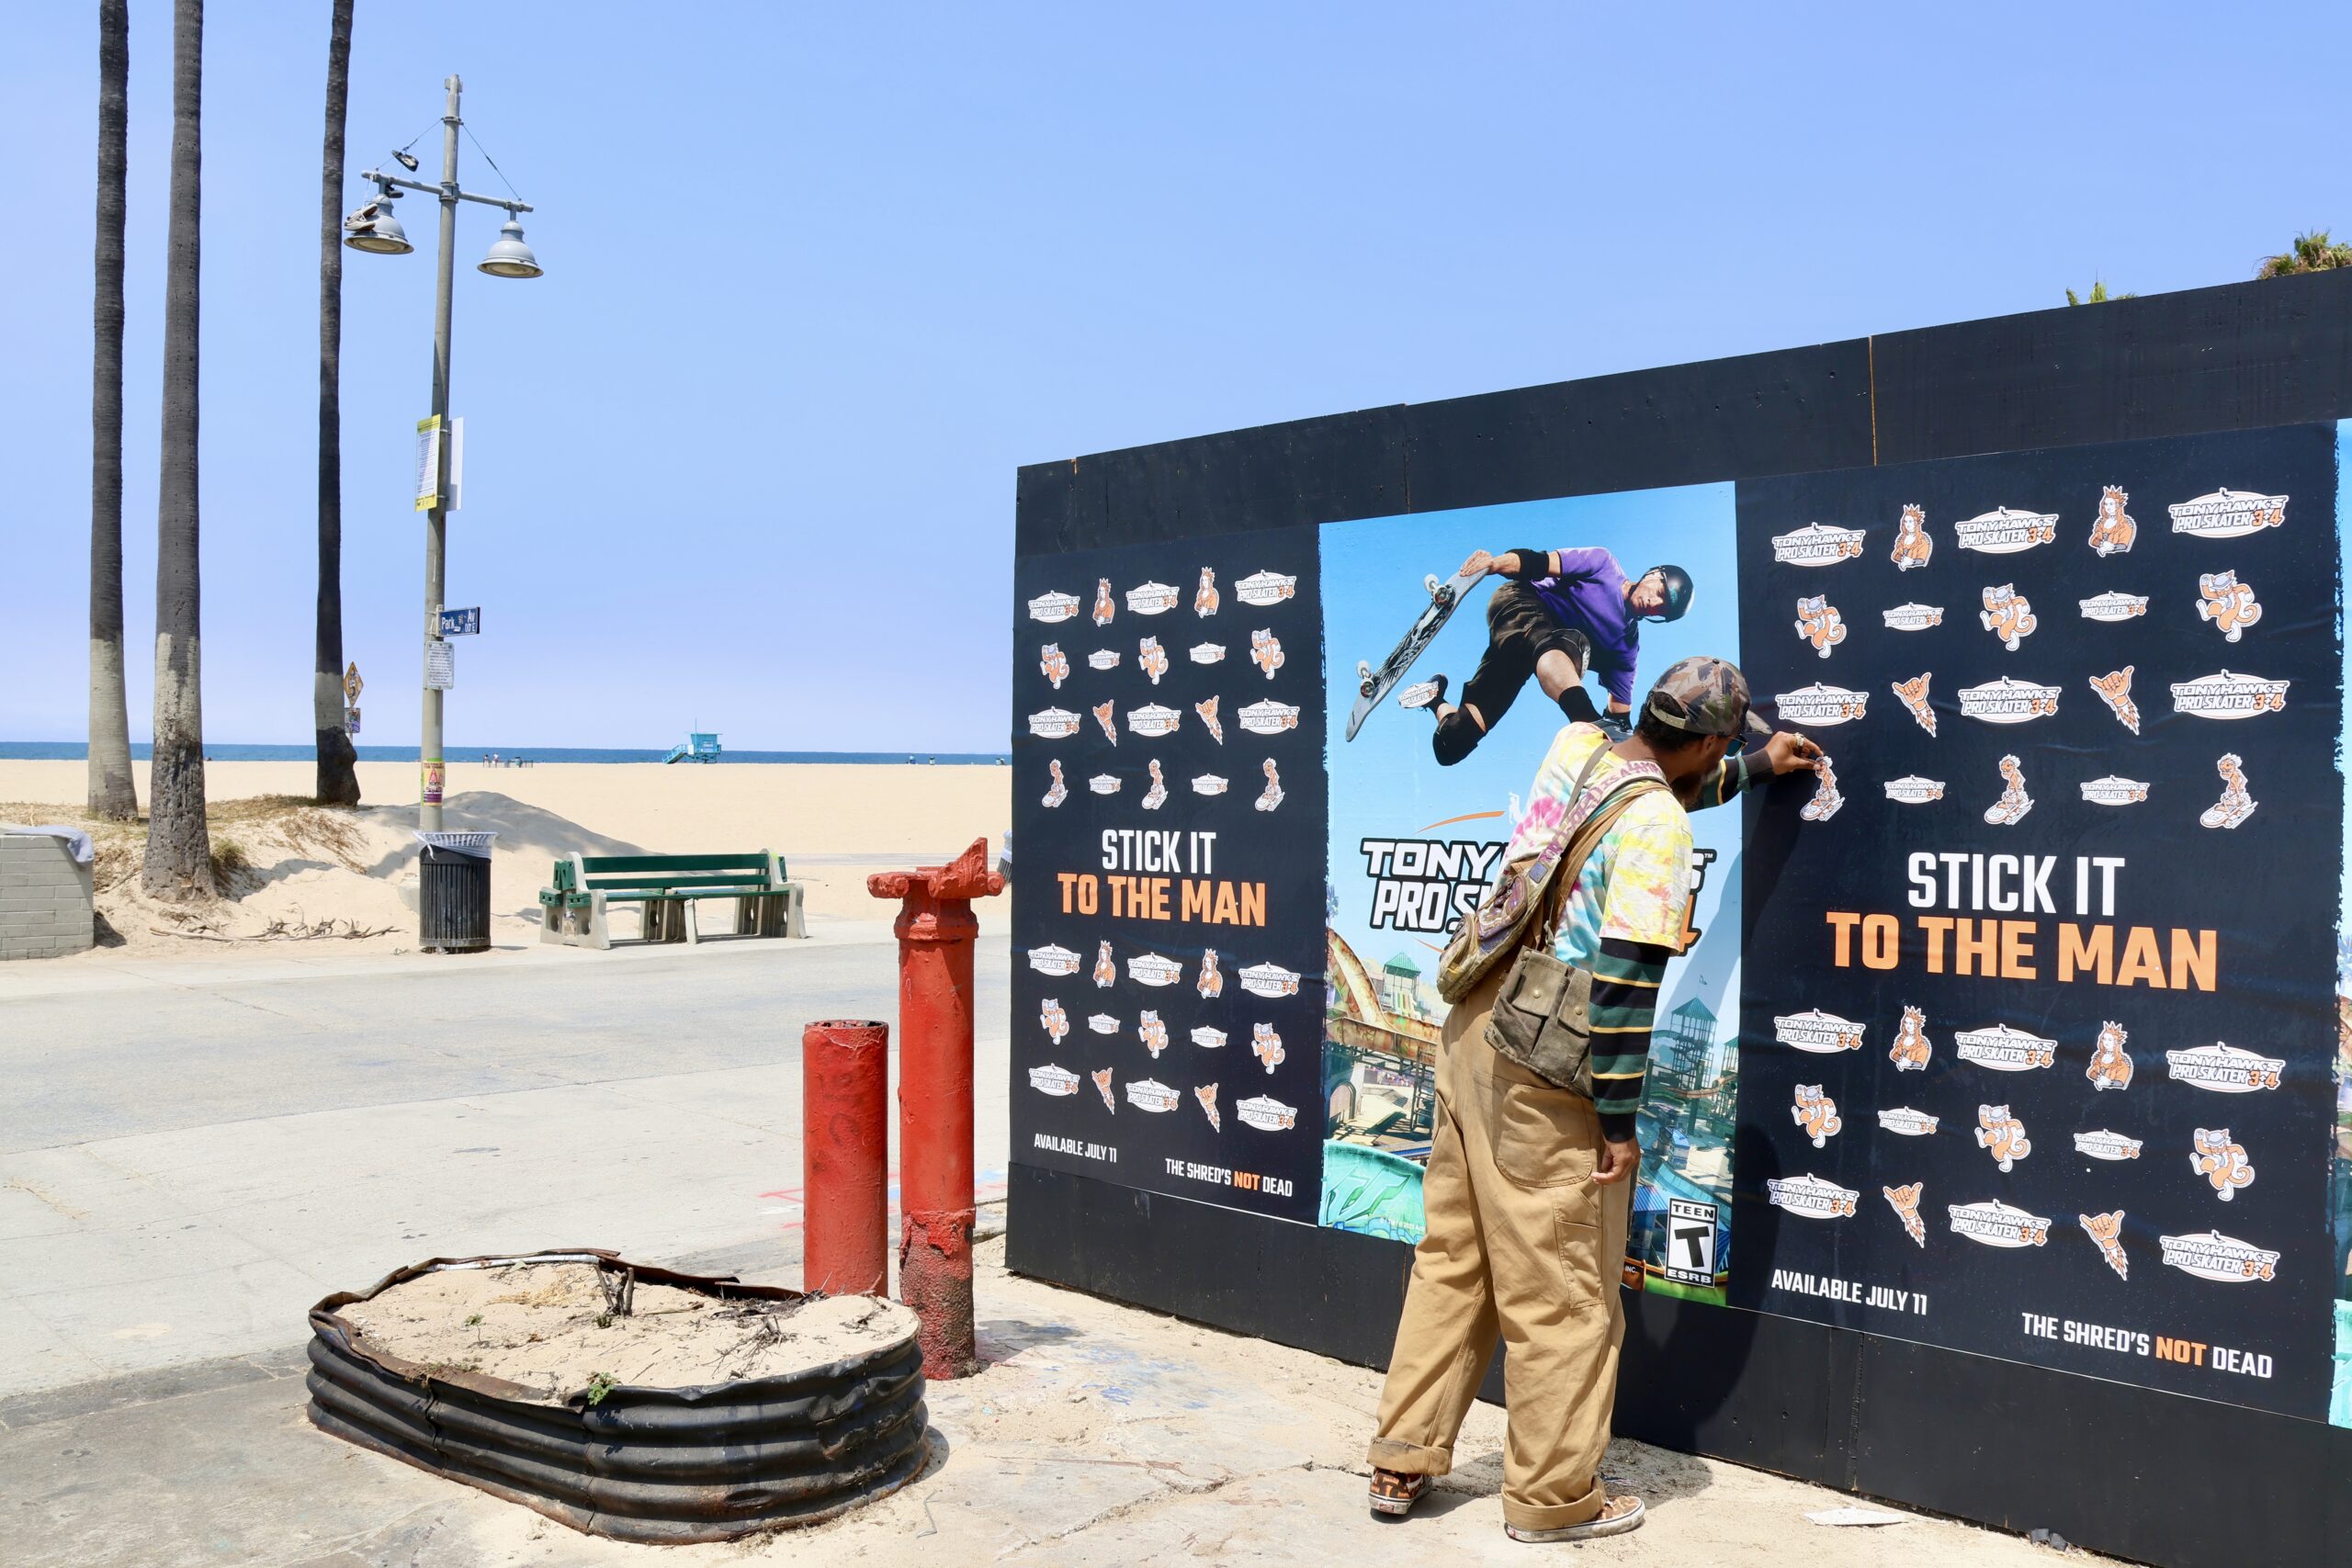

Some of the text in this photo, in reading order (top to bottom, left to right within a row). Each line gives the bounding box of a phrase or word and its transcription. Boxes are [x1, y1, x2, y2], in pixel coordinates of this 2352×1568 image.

[2175, 515, 2202, 530] PRO
[2200, 513, 2251, 528] SKATER
[1961, 532, 1984, 547] PRO
[1984, 529, 2026, 545] SKATER
[1777, 547, 1799, 559] PRO
[1798, 544, 1837, 558] SKATER
[442, 617, 454, 629] Park
[1781, 705, 1802, 717] PRO
[1801, 705, 1839, 717] SKATER
[1963, 701, 1987, 714] PRO
[1985, 701, 2029, 714] SKATER
[2177, 696, 2204, 710] PRO
[2202, 695, 2252, 709] SKATER
[1102, 829, 1216, 874] STICK IT
[1363, 841, 1500, 879] TONY
[1908, 852, 2125, 916] STICK IT
[1057, 874, 1265, 926] TO THE MAN
[1373, 880, 1449, 930] PRO
[1826, 912, 2216, 991] TO THE MAN
[1778, 1028, 1800, 1042] PRO
[1798, 1030, 1837, 1045] SKATER
[1960, 1044, 1984, 1059] PRO
[1982, 1046, 2025, 1063] SKATER
[2172, 1064, 2199, 1079] PRO
[2197, 1066, 2247, 1084] SKATER
[1035, 1134, 1116, 1163] AVAILABLE JULY 11
[1165, 1158, 1293, 1197] THE SHRED'S NOT DEAD
[1771, 1190, 1792, 1205] PRO
[1792, 1194, 1830, 1211] SKATER
[1673, 1204, 1713, 1219] TEEN
[1952, 1217, 1977, 1234] PRO
[1975, 1221, 2018, 1239] SKATER
[1674, 1226, 1710, 1268] T
[2165, 1249, 2193, 1267] PRO
[2191, 1254, 2242, 1274] SKATER
[1668, 1269, 1712, 1283] ESRB
[1771, 1269, 1927, 1315] AVAILABLE JULY 11
[2022, 1313, 2272, 1378] THE SHRED'S NOT DEAD
